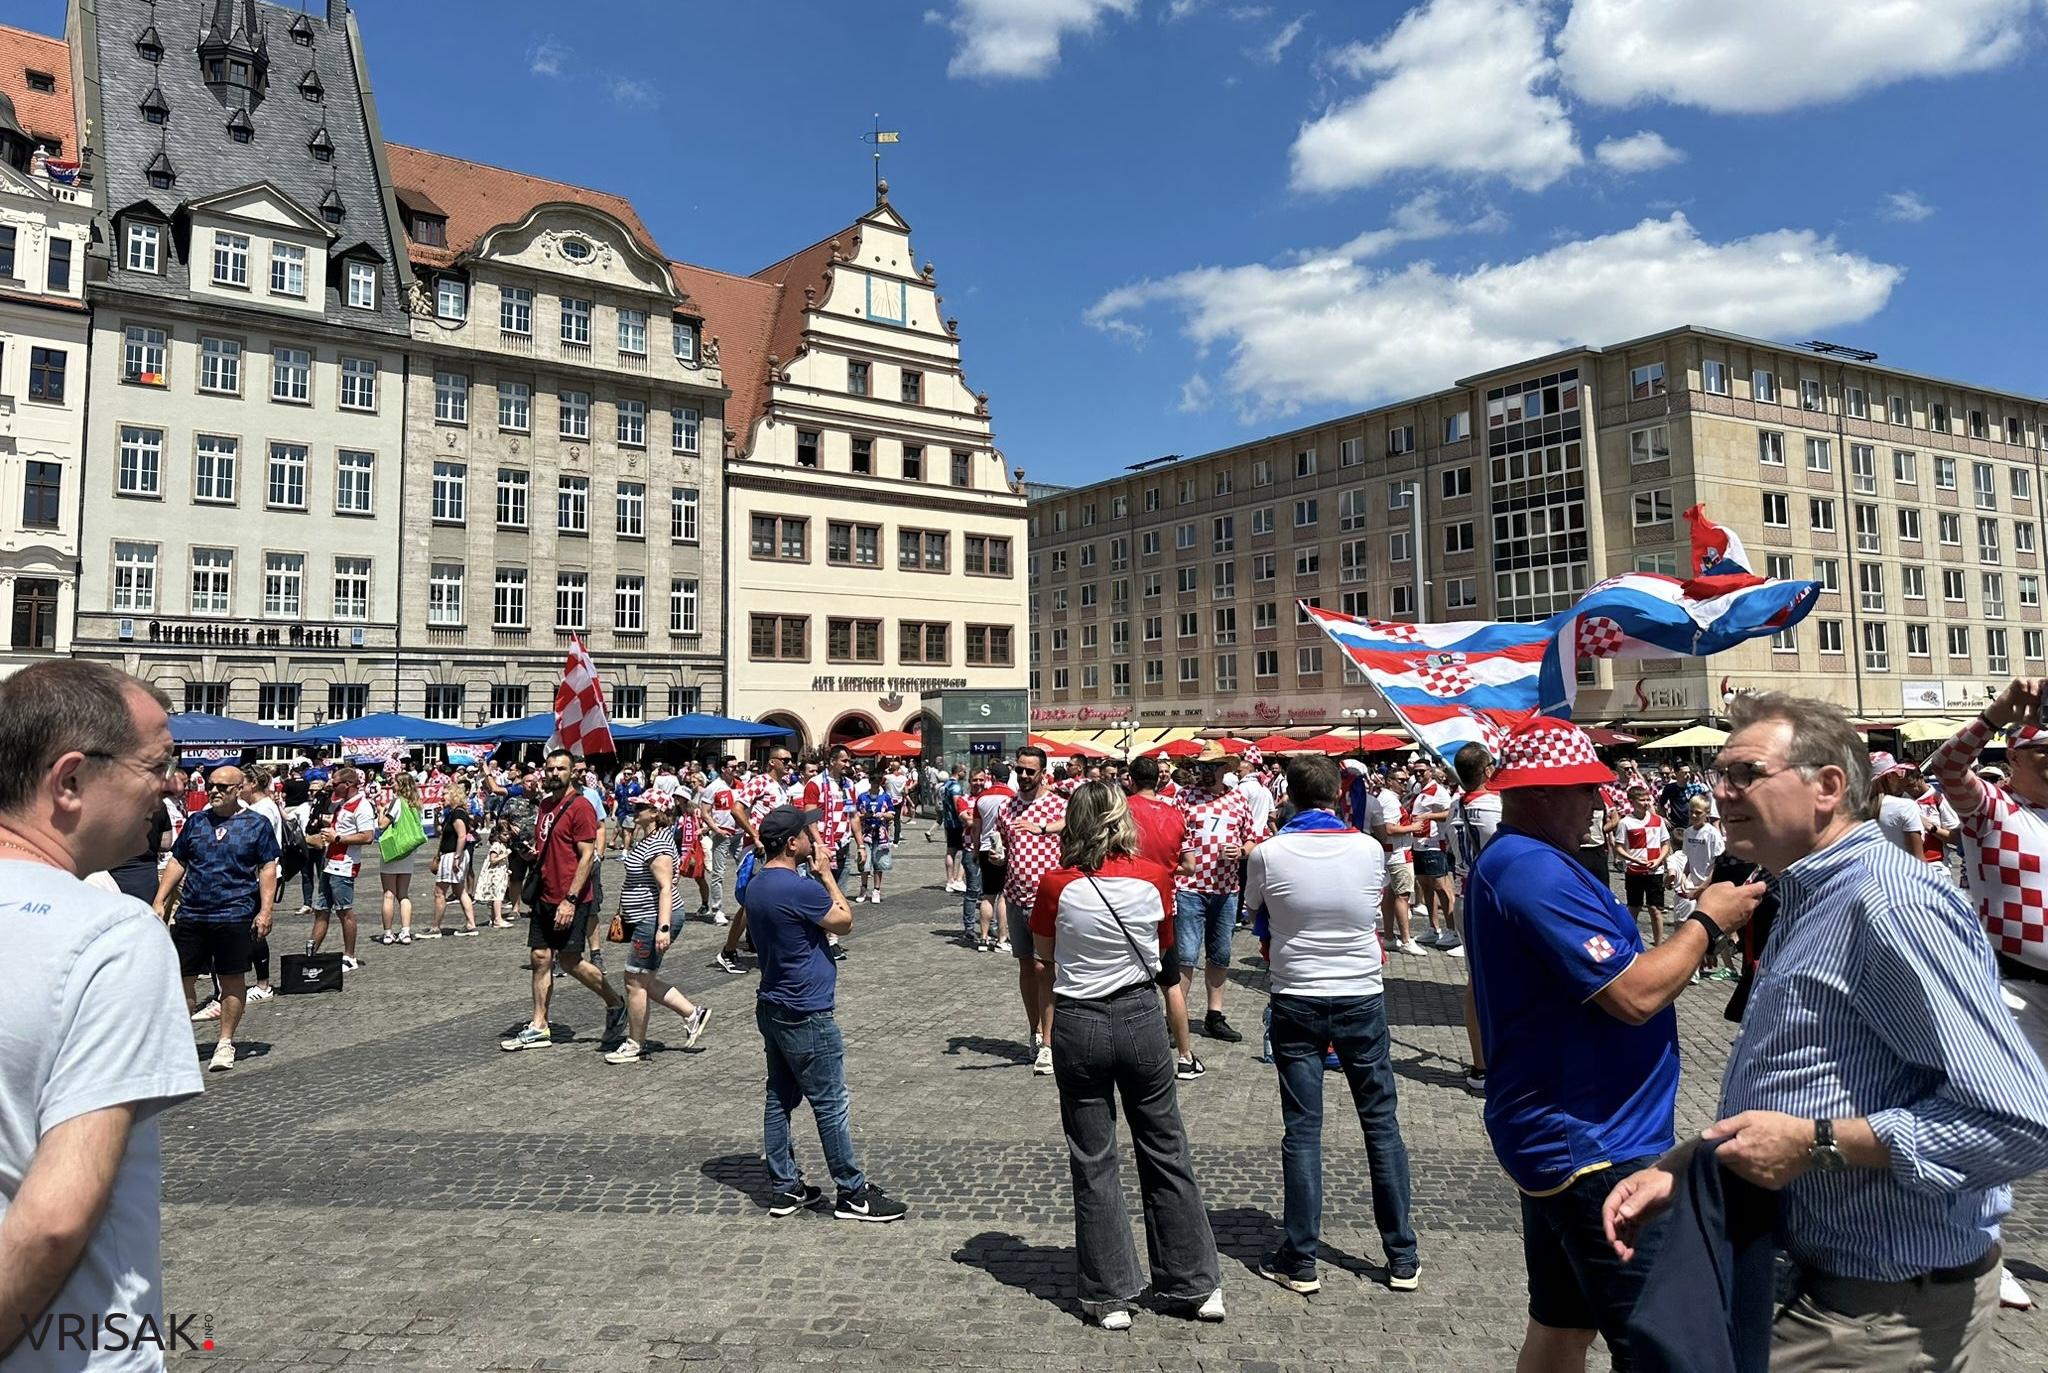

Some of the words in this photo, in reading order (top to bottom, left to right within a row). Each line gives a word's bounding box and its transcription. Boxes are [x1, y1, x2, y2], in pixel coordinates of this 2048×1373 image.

[981, 703, 991, 716] S
[1210, 816, 1220, 832] 7
[19, 902, 51, 915] AIR
